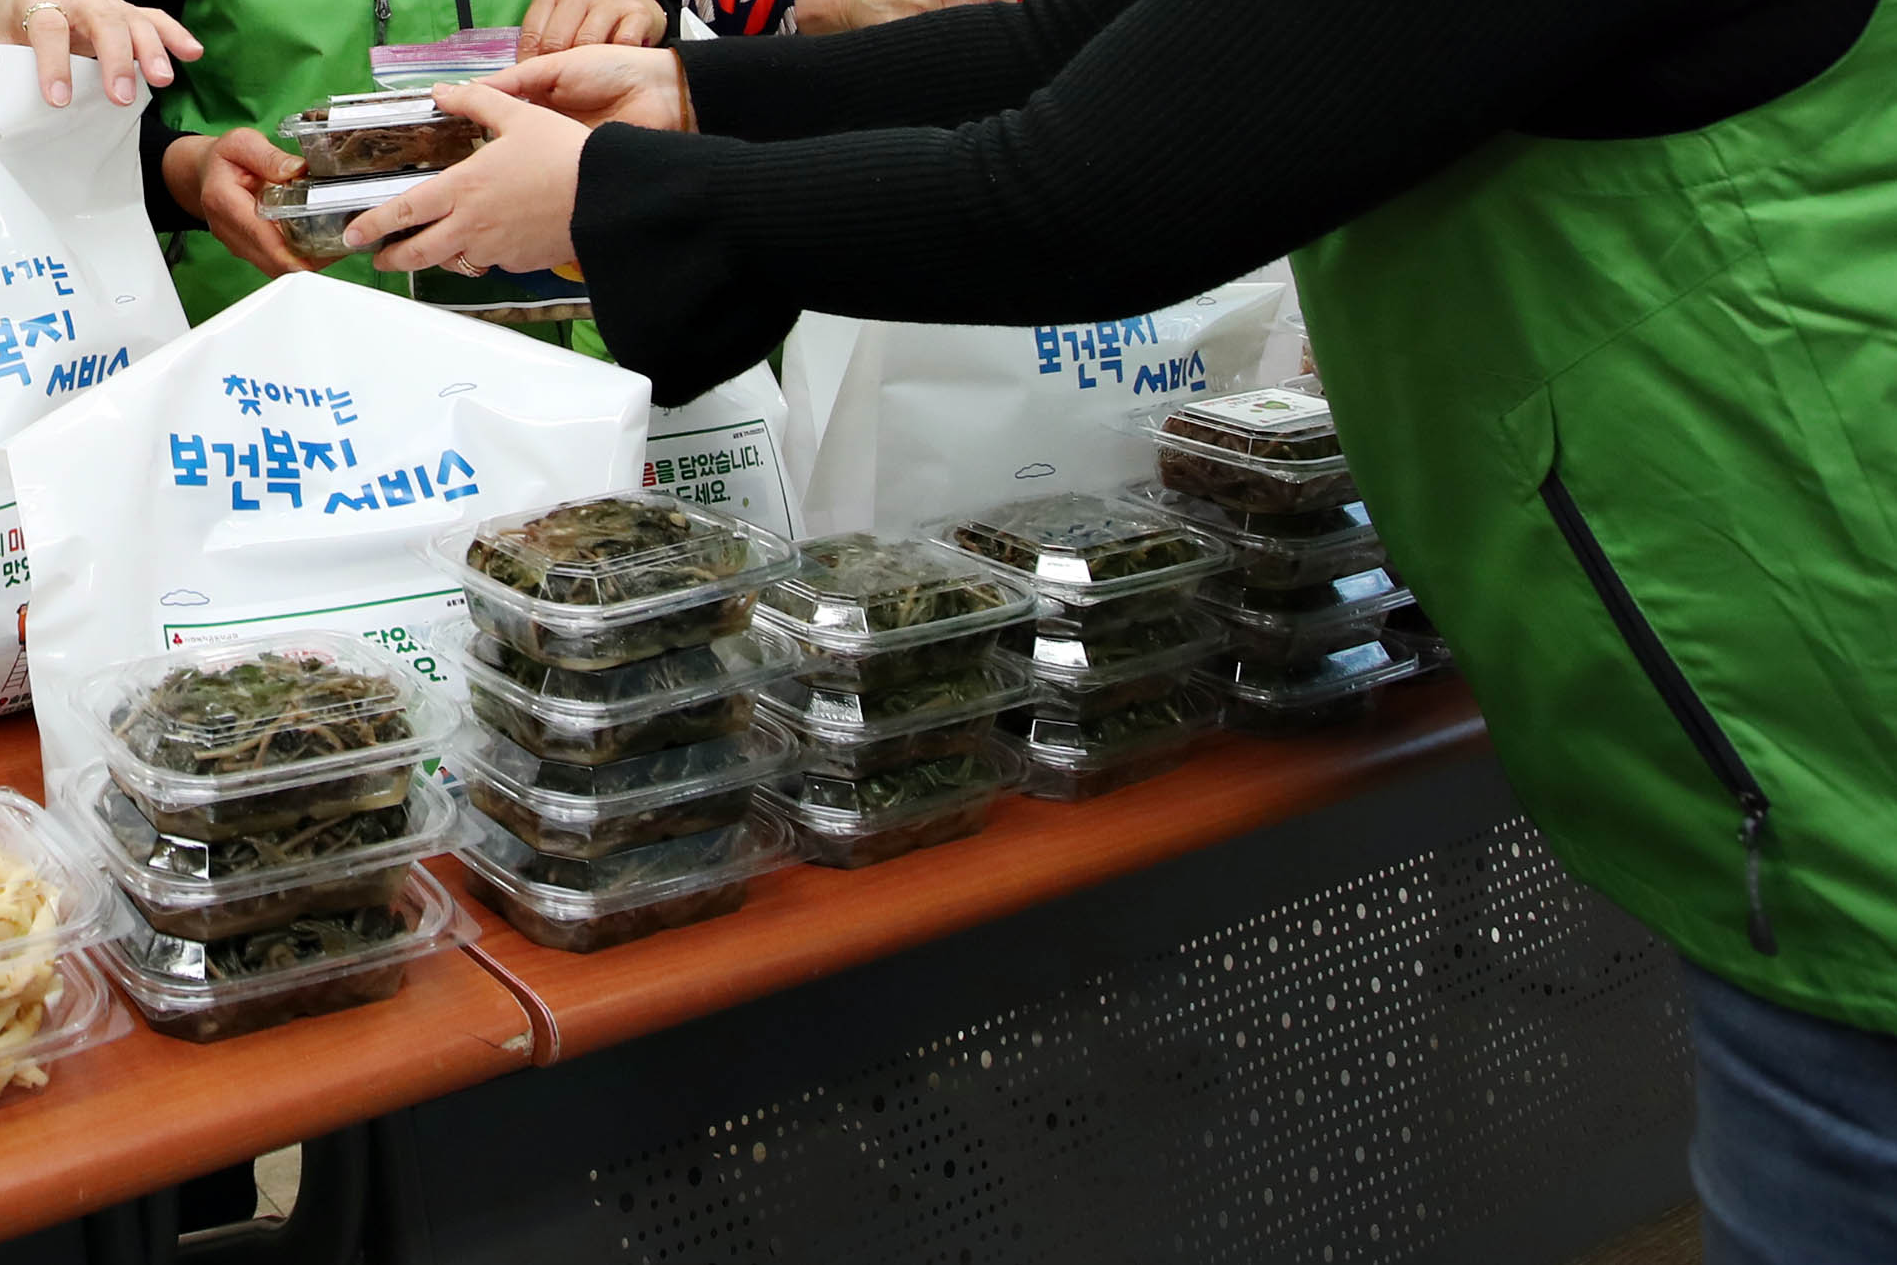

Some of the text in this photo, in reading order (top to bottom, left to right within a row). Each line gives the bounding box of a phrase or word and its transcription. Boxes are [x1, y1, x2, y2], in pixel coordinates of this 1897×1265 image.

[1034, 313, 1207, 396] 보건복지 서비스
[222, 374, 358, 426] 찾아가는
[169, 426, 480, 515] 보건복지 서비스
[678, 445, 764, 481] 담았습니다.
